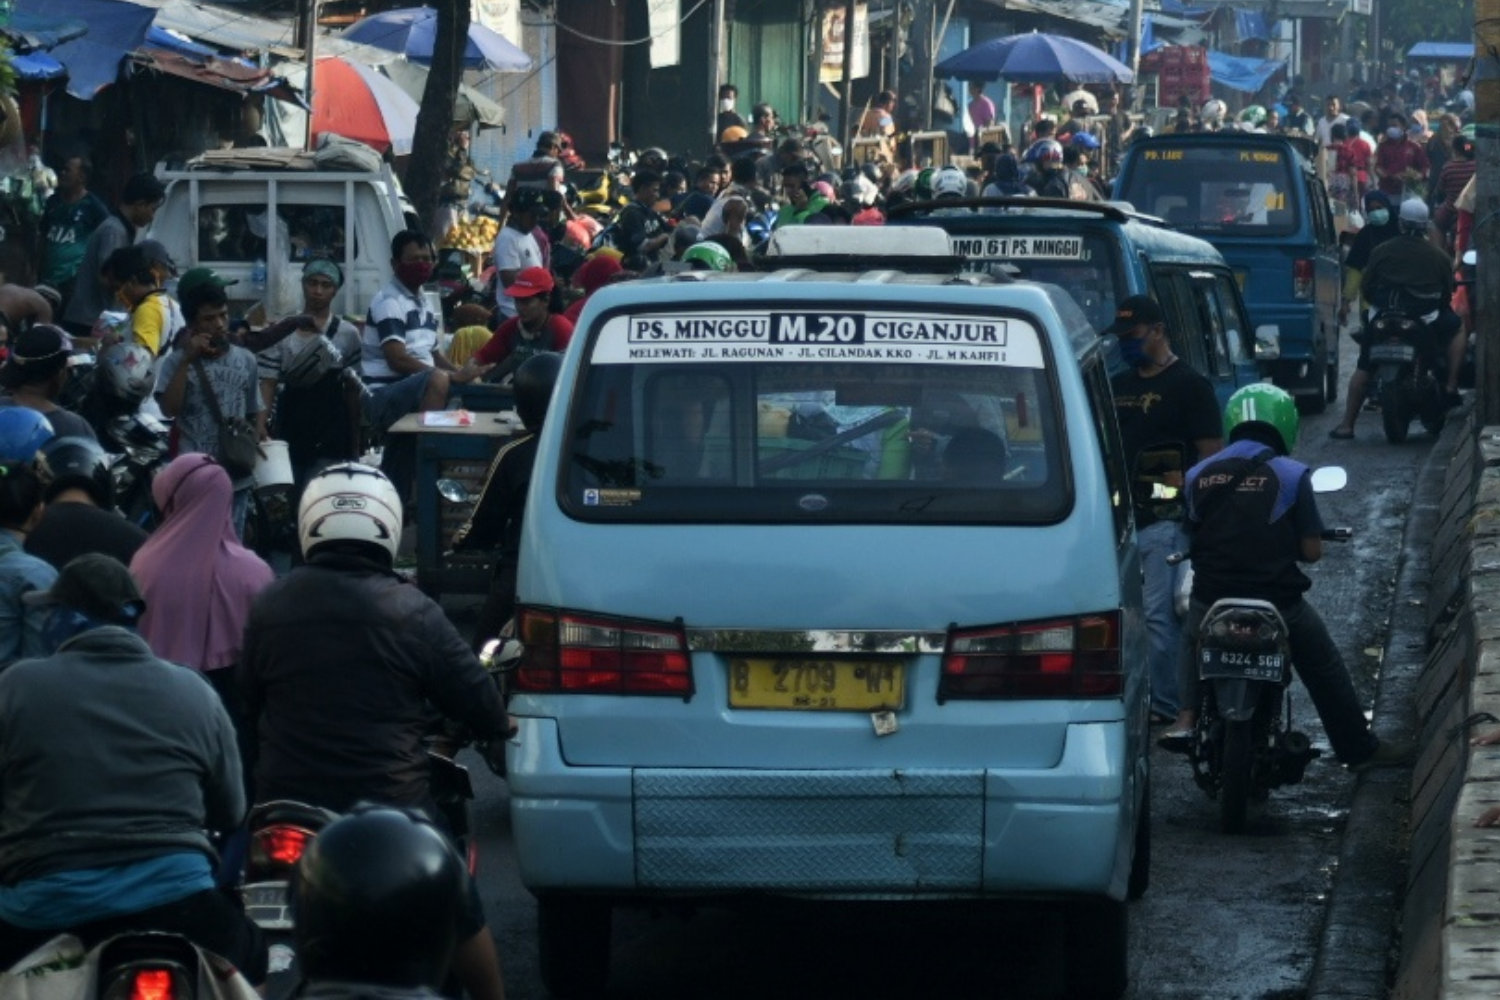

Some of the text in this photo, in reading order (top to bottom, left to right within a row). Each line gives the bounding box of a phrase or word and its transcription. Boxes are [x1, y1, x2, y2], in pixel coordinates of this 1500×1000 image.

[1012, 239, 1030, 255] PS.
[1033, 240, 1079, 255] MINGGU
[636, 315, 998, 343] PS. MINGGU M.20 CIGANJUR
[721, 347, 784, 358] RAGUNAN
[798, 348, 816, 359] JL.
[818, 347, 882, 358] CILANDAK
[886, 348, 912, 359] KKO
[773, 659, 836, 693] 2709
